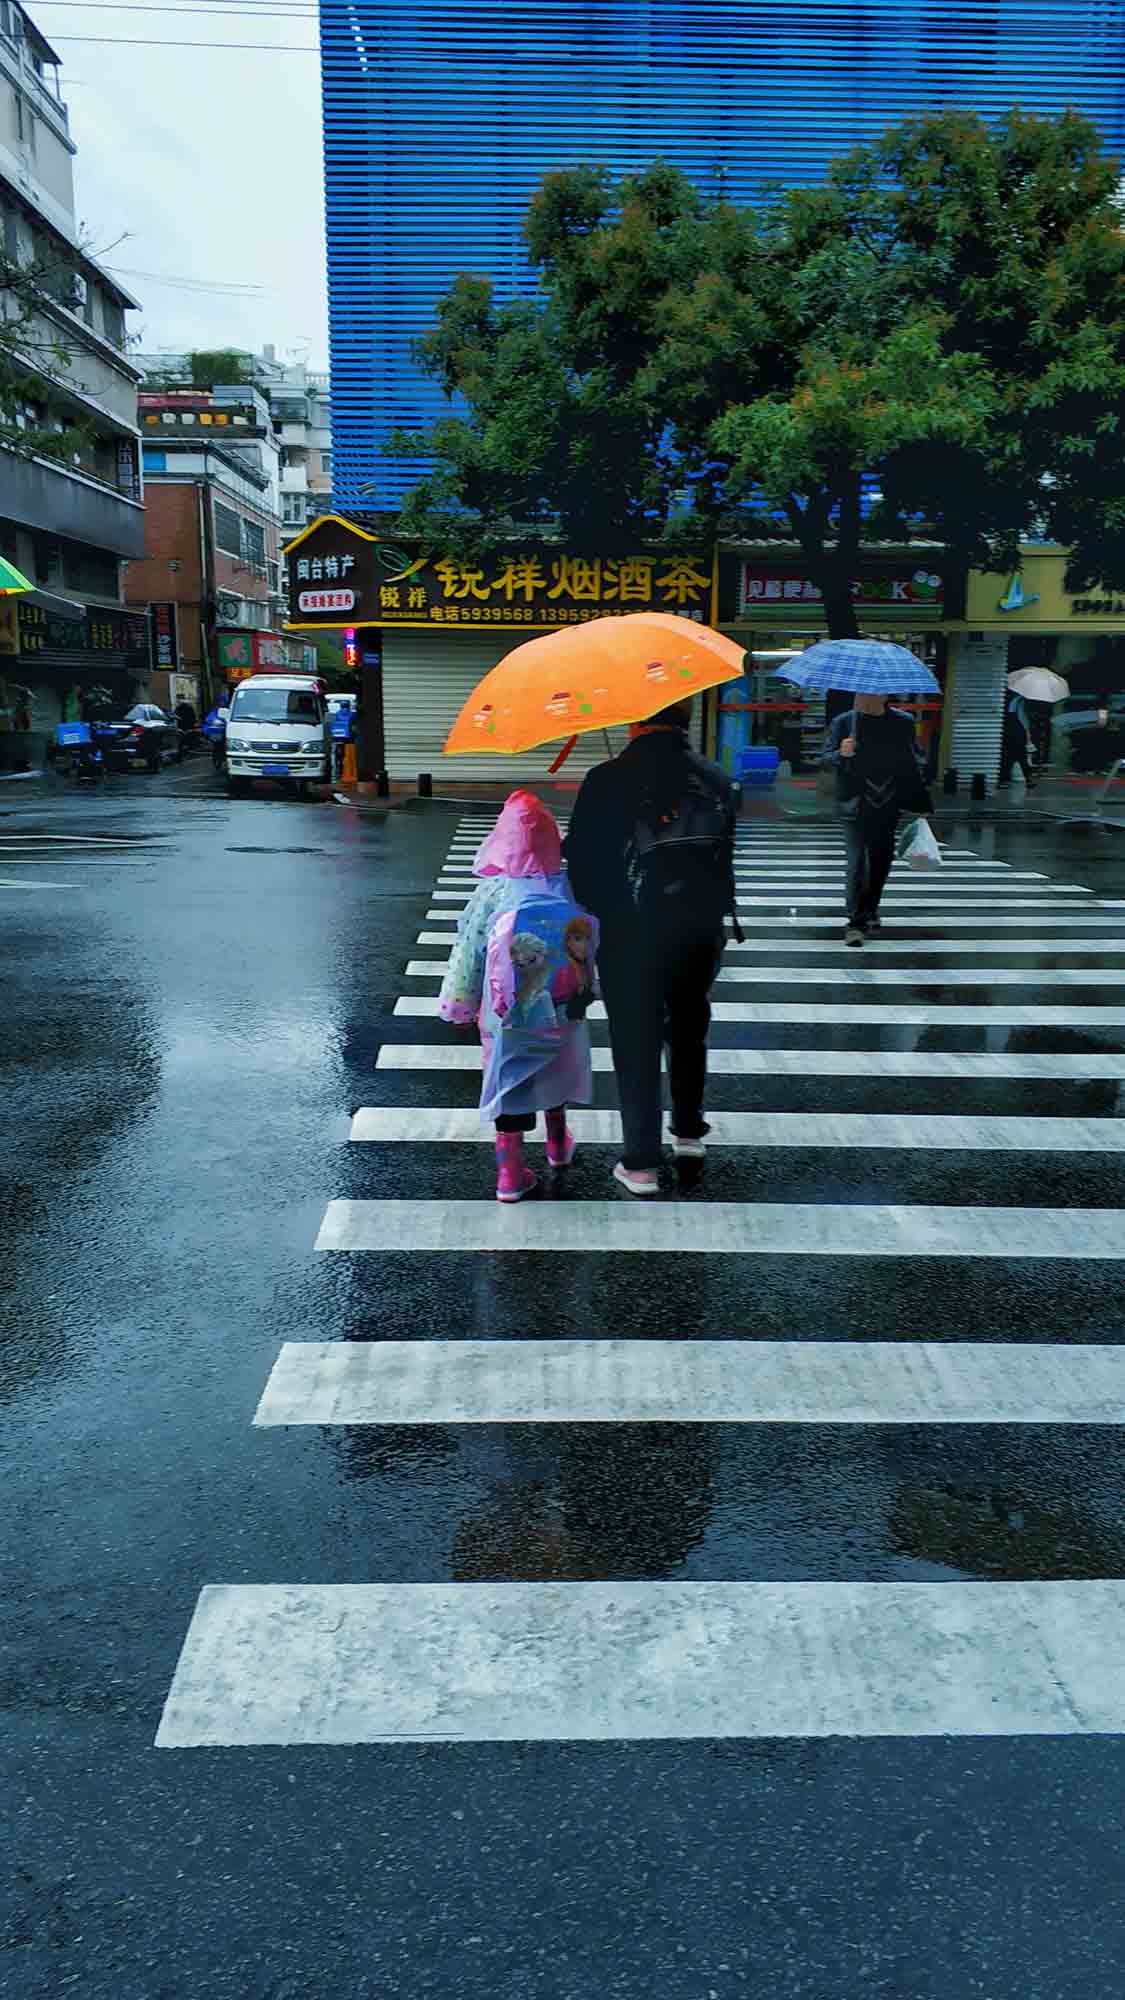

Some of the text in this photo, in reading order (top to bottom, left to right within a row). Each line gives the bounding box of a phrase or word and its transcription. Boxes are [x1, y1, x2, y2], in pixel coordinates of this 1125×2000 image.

[297, 554, 354, 580] 闽台特产
[434, 553, 711, 603] 锐祥烟酒茶
[380, 586, 427, 608] 锐祥
[430, 606, 534, 622] 电话5939568
[539, 607, 656, 623] 1395929
